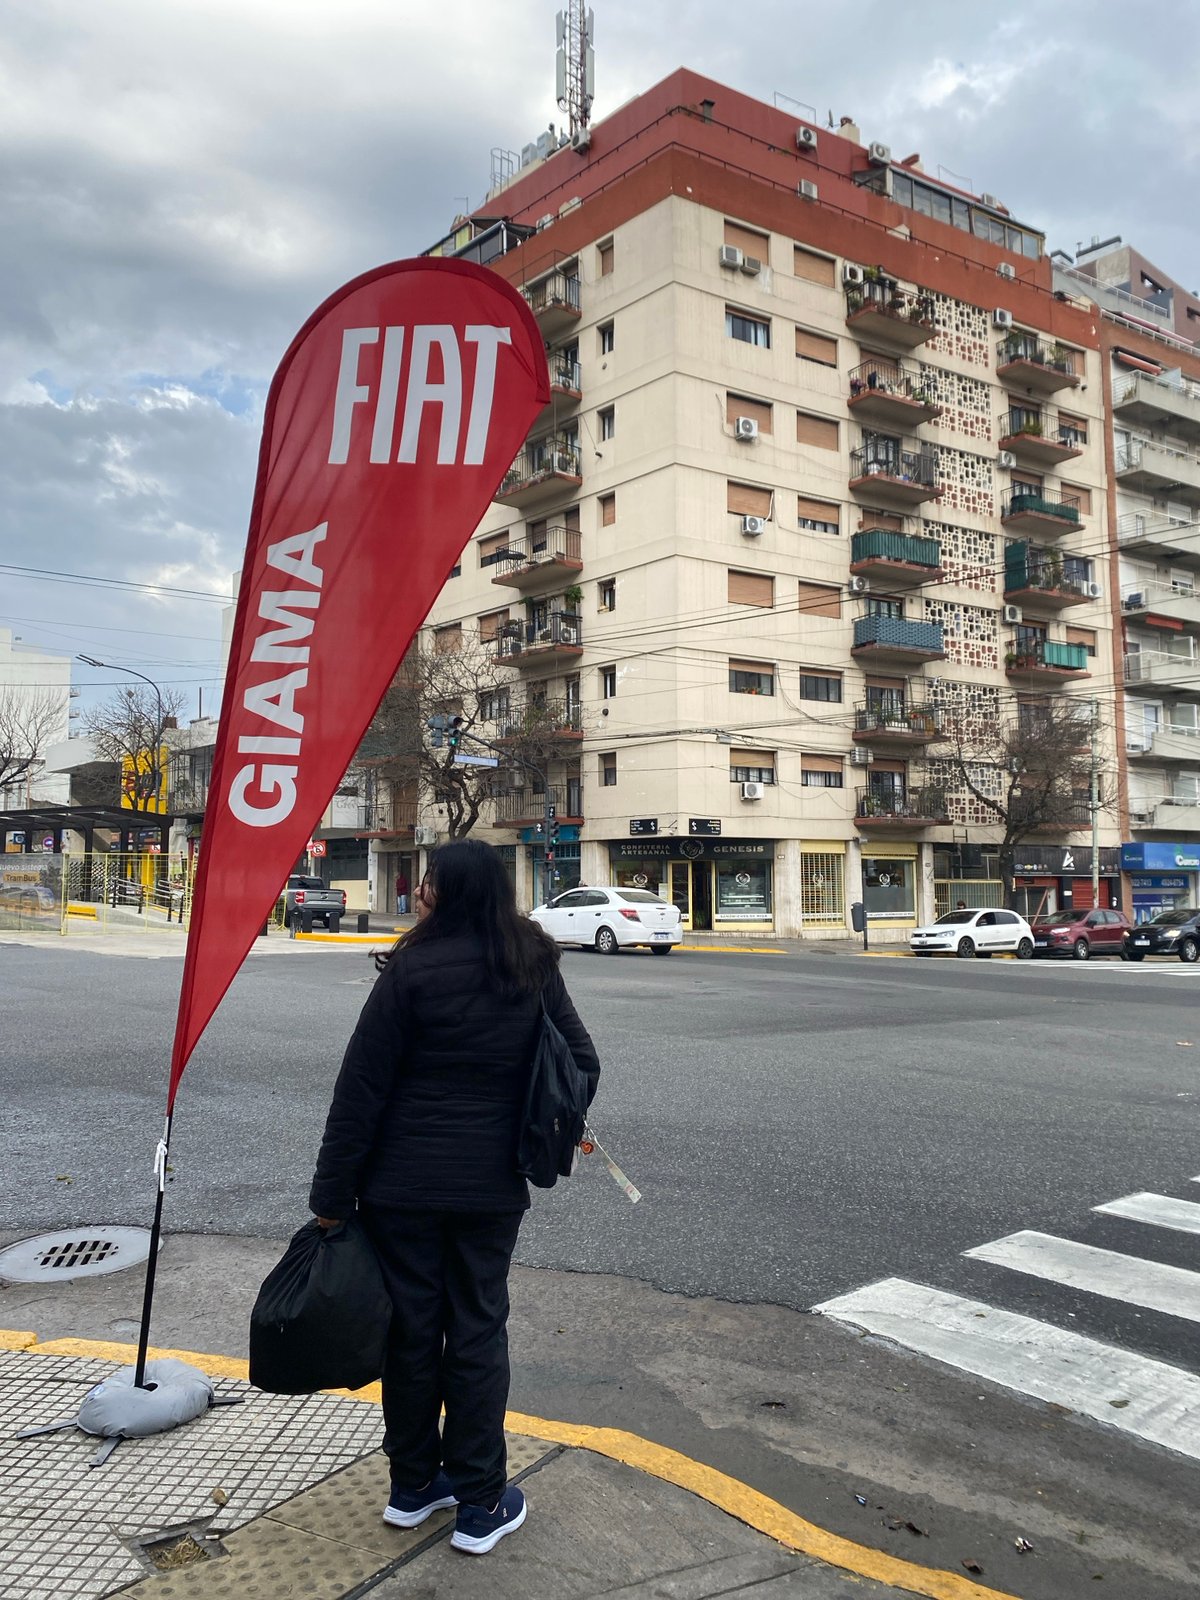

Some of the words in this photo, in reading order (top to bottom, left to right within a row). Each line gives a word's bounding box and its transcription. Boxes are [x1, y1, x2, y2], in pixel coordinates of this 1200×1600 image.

[327, 324, 512, 466] FIAT
[228, 520, 329, 828] GIAMA
[5, 874, 37, 882] TramBus
[713, 845, 765, 853] GENESIS
